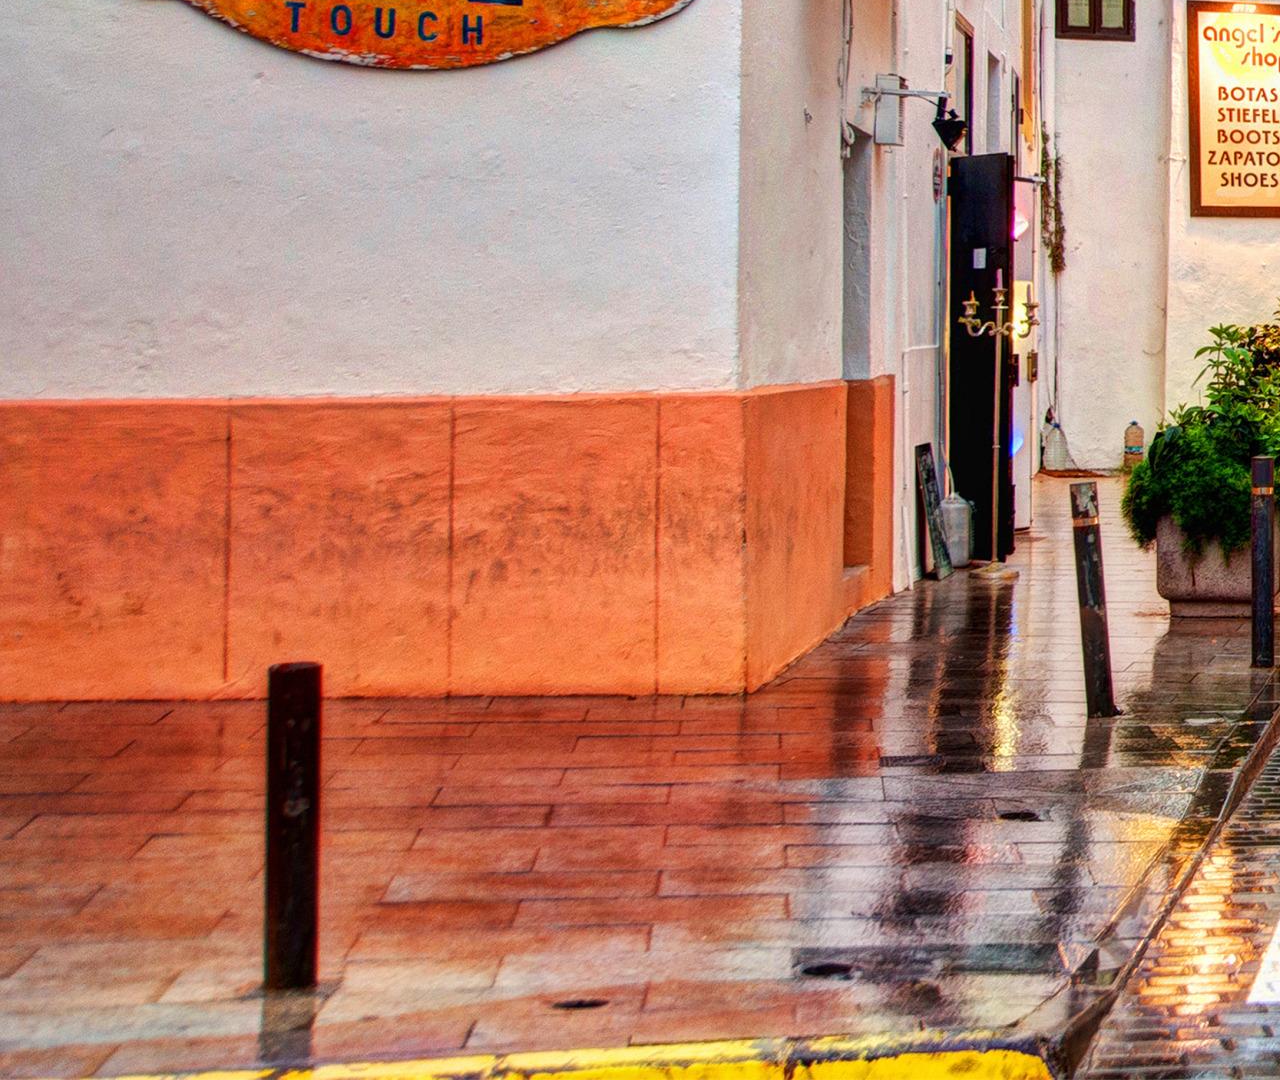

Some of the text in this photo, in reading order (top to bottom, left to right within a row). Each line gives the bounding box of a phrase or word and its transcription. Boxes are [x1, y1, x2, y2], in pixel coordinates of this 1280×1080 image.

[285, 0, 485, 46] TOUCH
[1218, 87, 1278, 102] BOTAS
[1217, 108, 1280, 124] STIEFEL
[1217, 130, 1280, 145] BOOTS
[1221, 173, 1278, 188] SHOES
